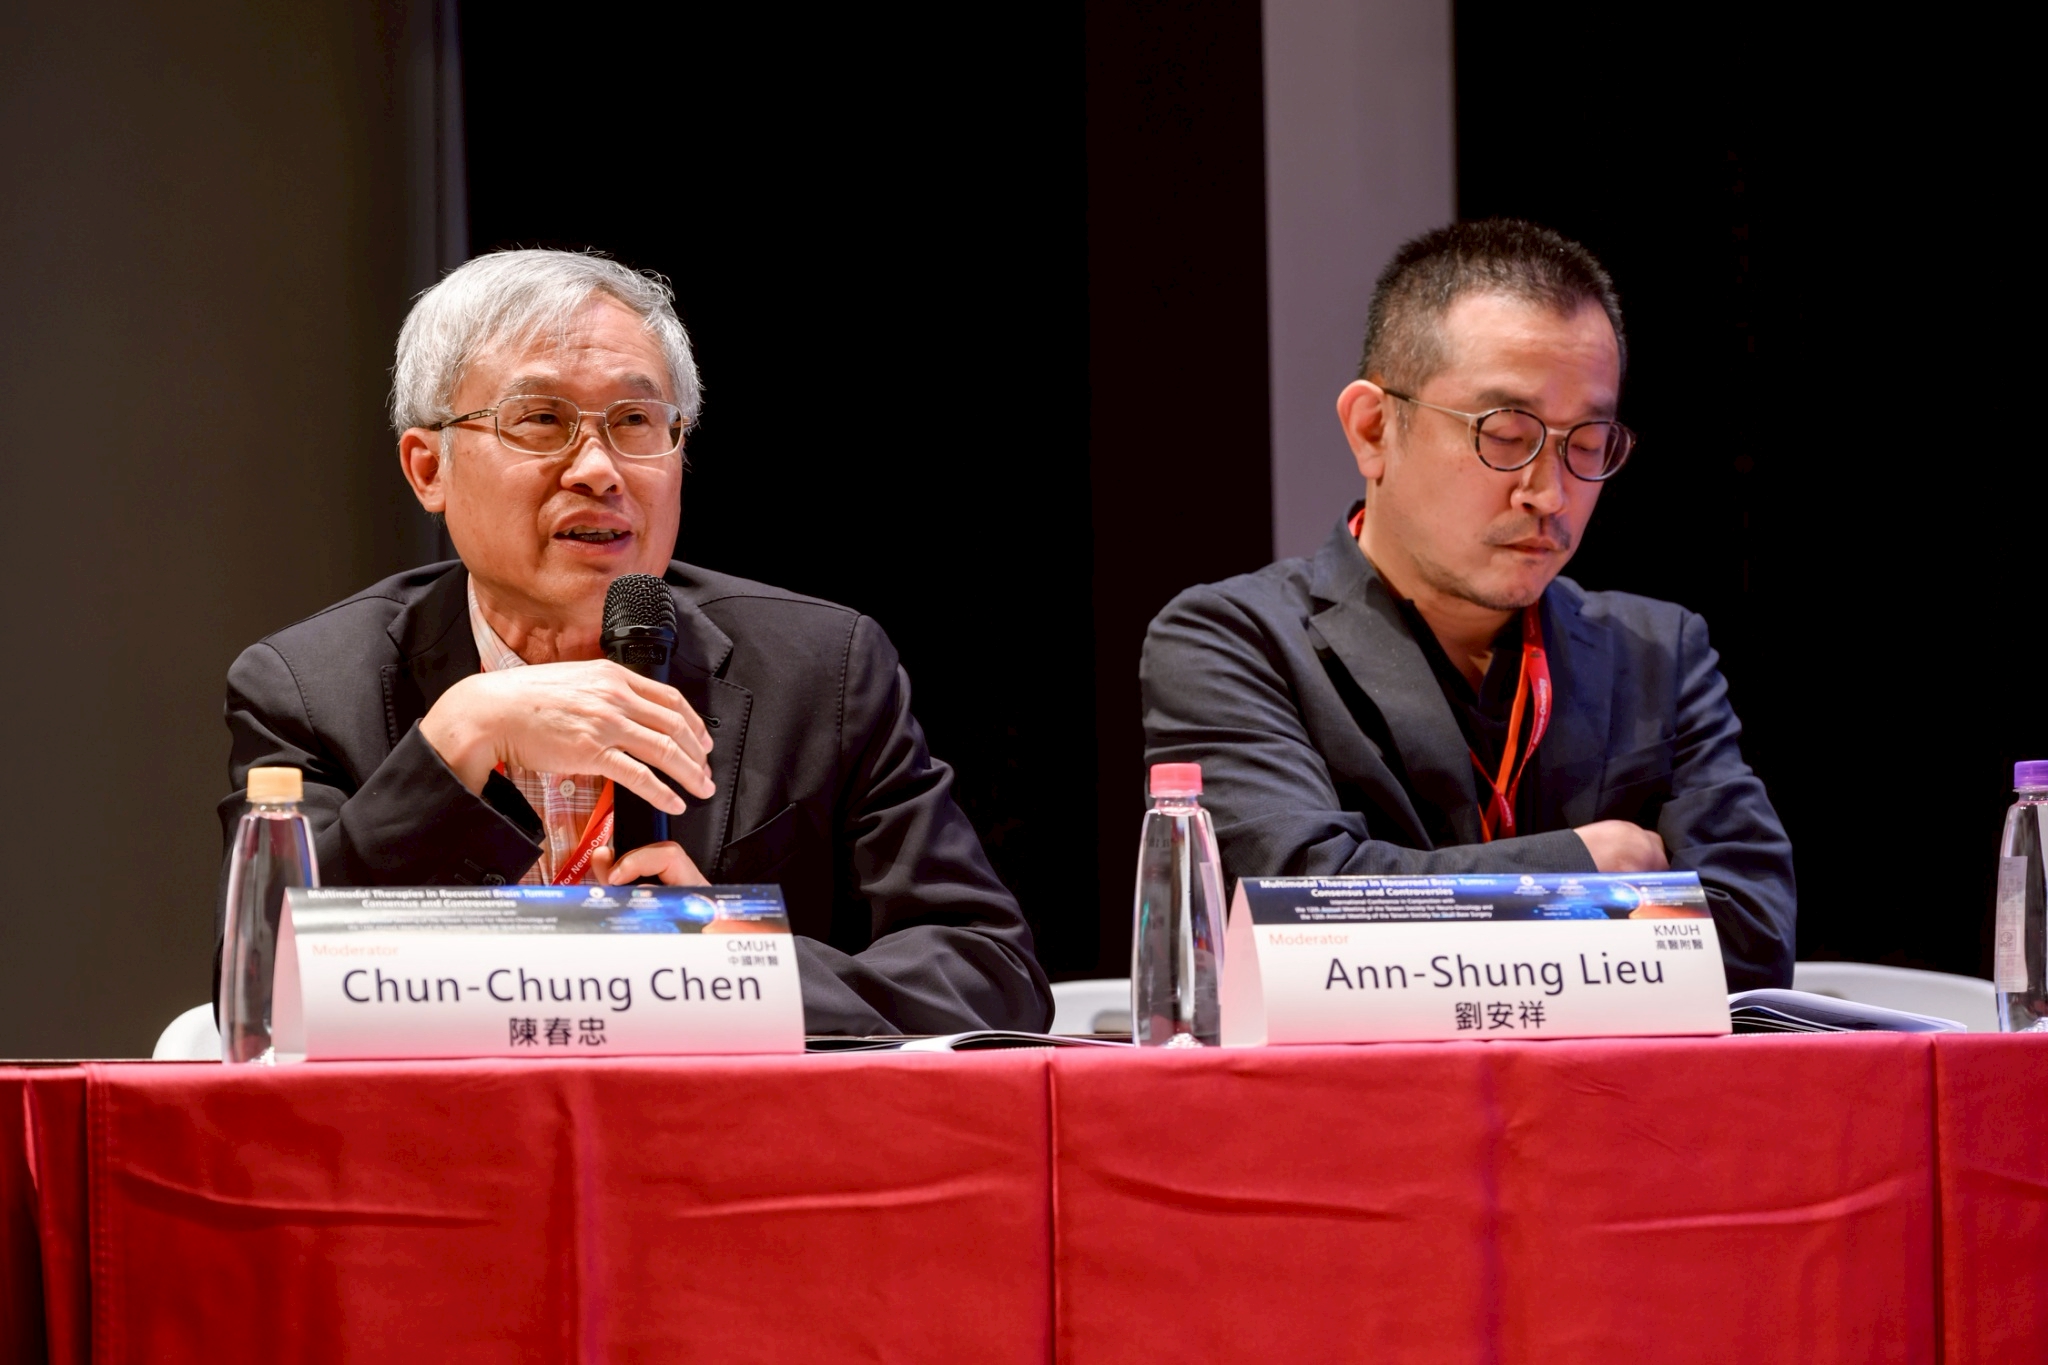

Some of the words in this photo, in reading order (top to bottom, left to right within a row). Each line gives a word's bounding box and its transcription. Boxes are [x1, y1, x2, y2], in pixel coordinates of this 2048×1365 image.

[570, 814, 614, 875] Neuro-Oncolo
[1260, 879, 1318, 889] Multimodal
[1318, 879, 1369, 889] Therapies
[1369, 879, 1381, 888] in
[1381, 878, 1430, 888] Recurrent
[1430, 878, 1457, 887] Brain
[306, 889, 371, 899] Multimodal
[371, 889, 425, 900] Therapies
[426, 889, 439, 899] in
[439, 889, 492, 899] Recurrent
[492, 889, 521, 899] Brain
[1310, 888, 1364, 898] Consensus
[1365, 888, 1385, 897] and
[1386, 887, 1455, 897] Controversies
[361, 899, 420, 909] Consensus
[420, 899, 442, 908] and
[443, 898, 517, 908] Controversies
[1653, 924, 1701, 937] KMUH
[726, 939, 777, 952] CMUH
[1269, 932, 1349, 946] Moderator
[1655, 938, 1704, 951] 高醫附醫
[311, 943, 399, 957] Moderator
[728, 955, 779, 967] 中國附醫
[1325, 954, 1565, 996] Ann-Shung
[1580, 952, 1664, 985] Lieu
[341, 968, 633, 1012] Chun-Chung
[650, 967, 762, 1001] Chen
[1454, 1000, 1547, 1031] 劉安祥
[508, 1016, 608, 1047] 陳春忠
